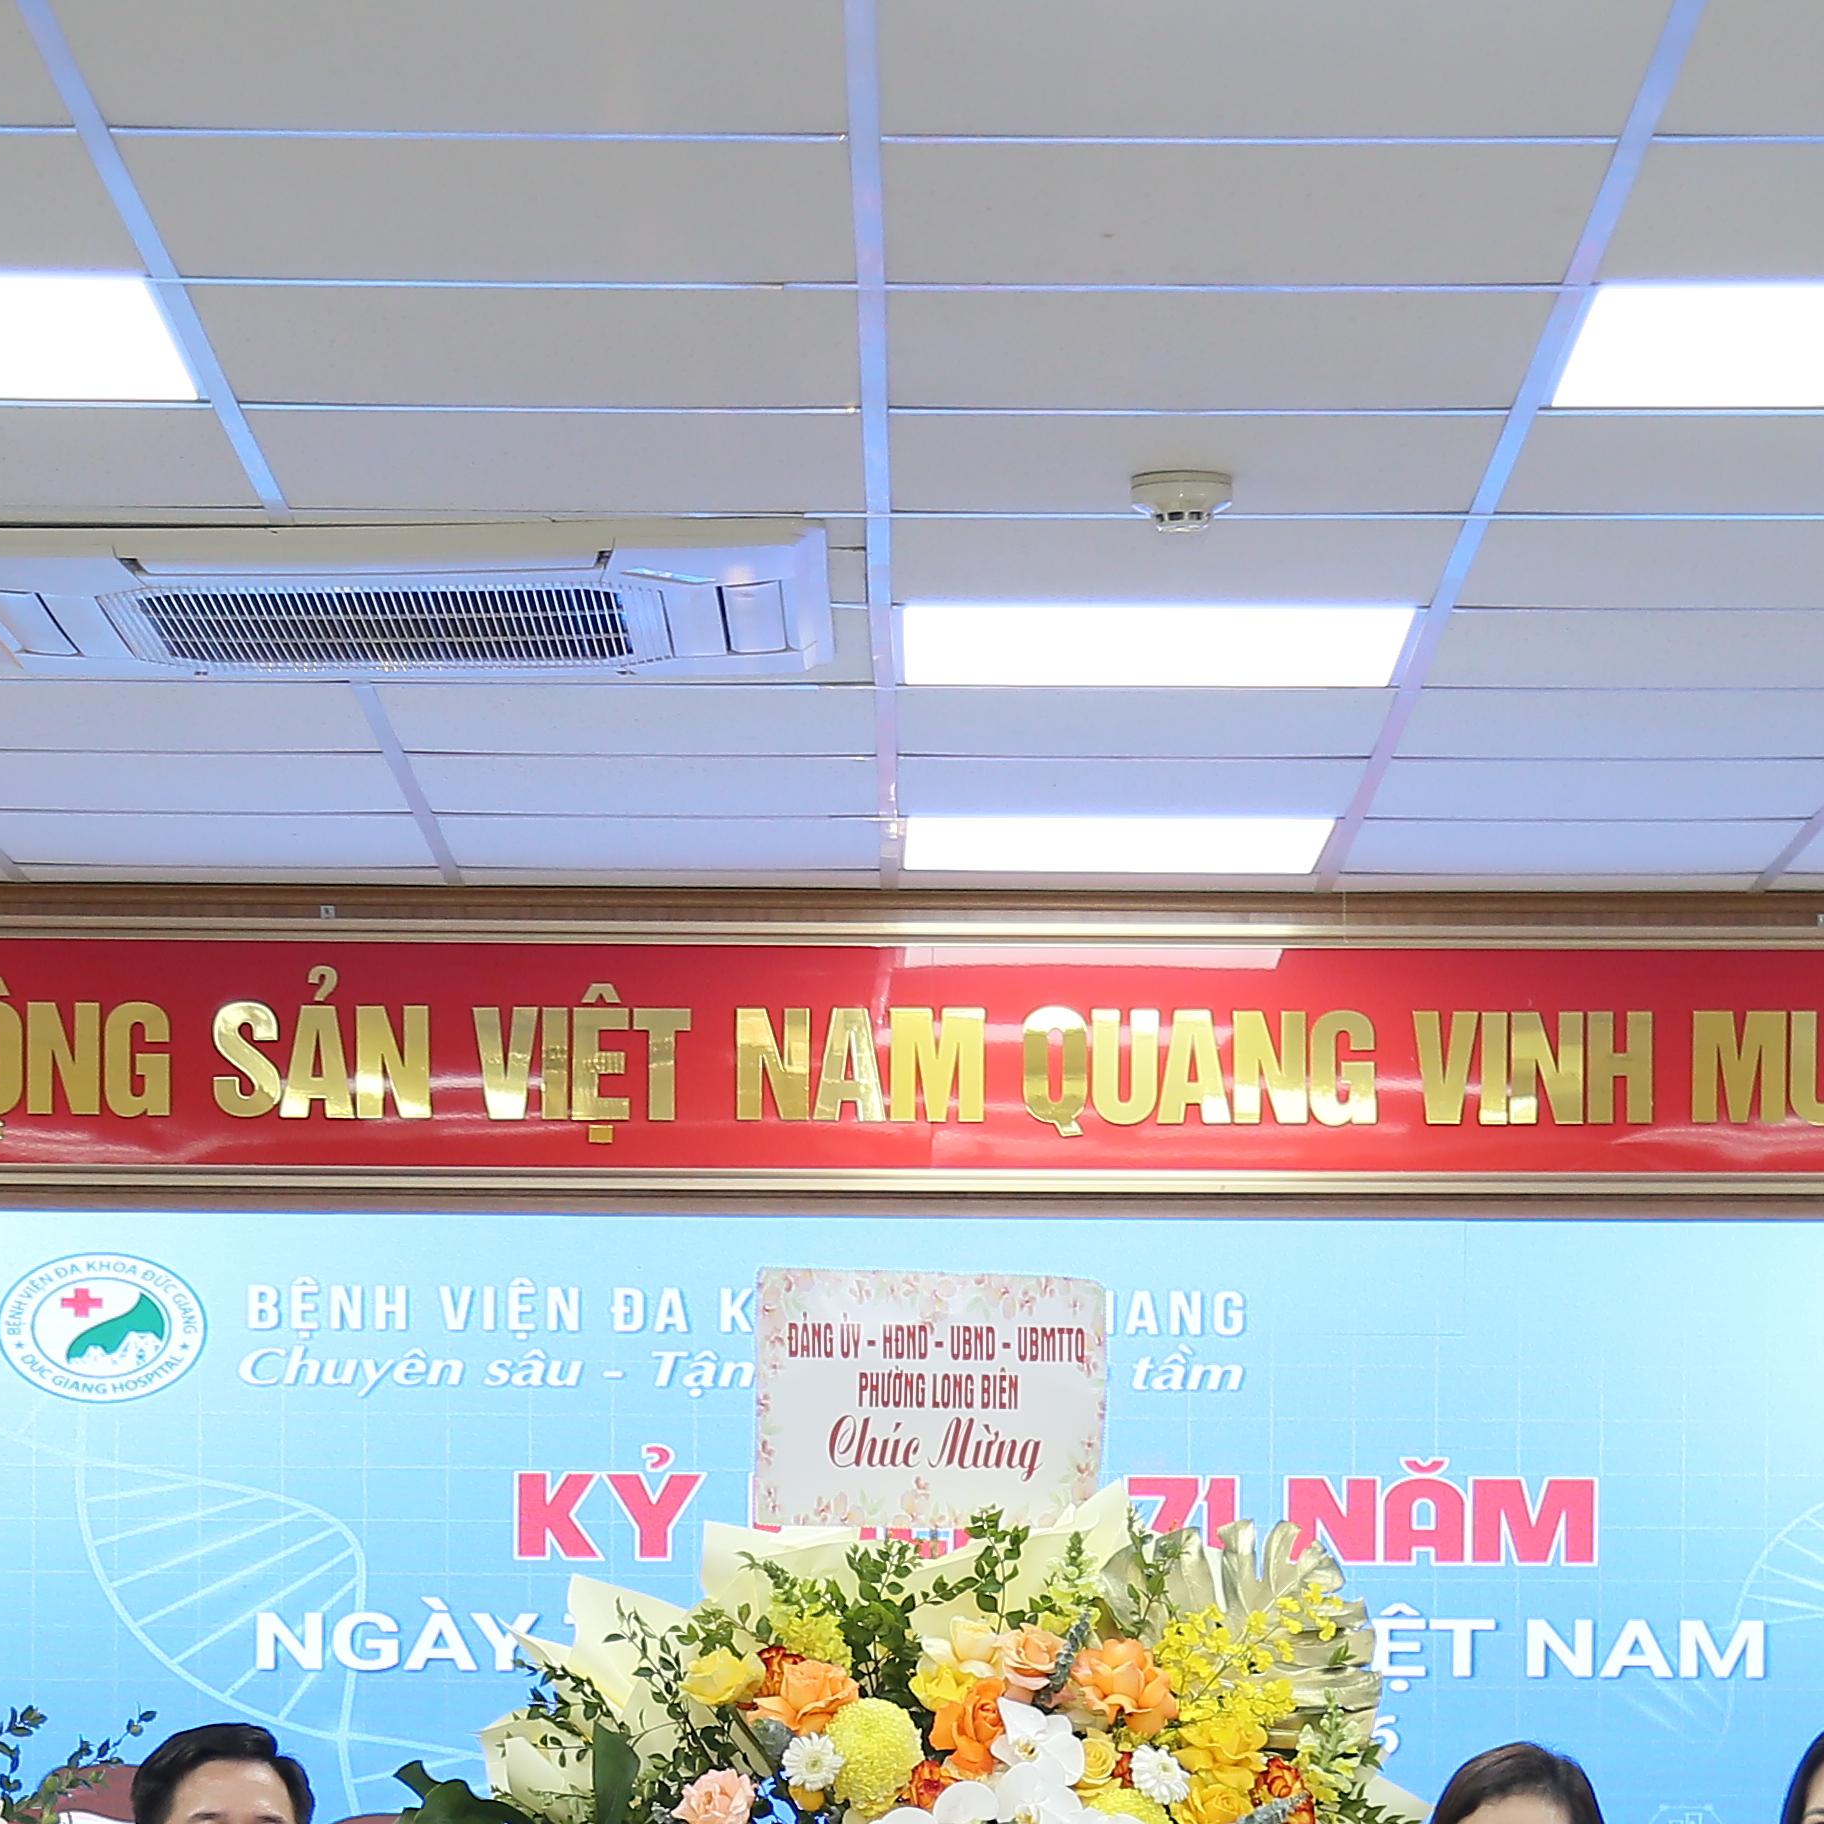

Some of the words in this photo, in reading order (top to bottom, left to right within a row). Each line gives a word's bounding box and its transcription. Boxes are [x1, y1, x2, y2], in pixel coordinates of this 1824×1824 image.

[212, 964, 434, 1123] SẢN
[477, 983, 693, 1145] VIỆT
[734, 1005, 986, 1126] NAM
[1021, 1006, 1378, 1139] QUANG
[1411, 1008, 1655, 1128] VINH
[85, 1260, 138, 1277] KHOA
[246, 1277, 409, 1340] BỆNH
[439, 1278, 582, 1341] VIỆN
[610, 1286, 690, 1334] ĐA
[787, 1311, 834, 1359] ĐẢNG
[839, 1311, 862, 1360] ỦY
[882, 1323, 928, 1361] HĐND
[949, 1325, 996, 1362] UBND
[1017, 1326, 1086, 1365] UBMTTQ
[1105, 1288, 1248, 1338] IANG
[51, 1374, 108, 1395] GIANG
[111, 1355, 185, 1395] HOSPITAL
[238, 1346, 463, 1398] Chuyên
[482, 1348, 583, 1389] sâu
[651, 1350, 755, 1398] Tận
[858, 1365, 926, 1410] PHƯỜNG
[931, 1373, 975, 1410] LONG
[980, 1366, 1020, 1411] BIÊN
[1131, 1343, 1246, 1392] tầm
[828, 1414, 921, 1469] Chúc
[928, 1416, 1045, 1482] Mừng
[514, 1444, 706, 1562] KỶ
[1283, 1458, 1599, 1567] NĂM
[255, 1595, 540, 1672] NGÀY
[1370, 1602, 1497, 1693] ỆT
[1525, 1617, 1768, 1680] NAM
